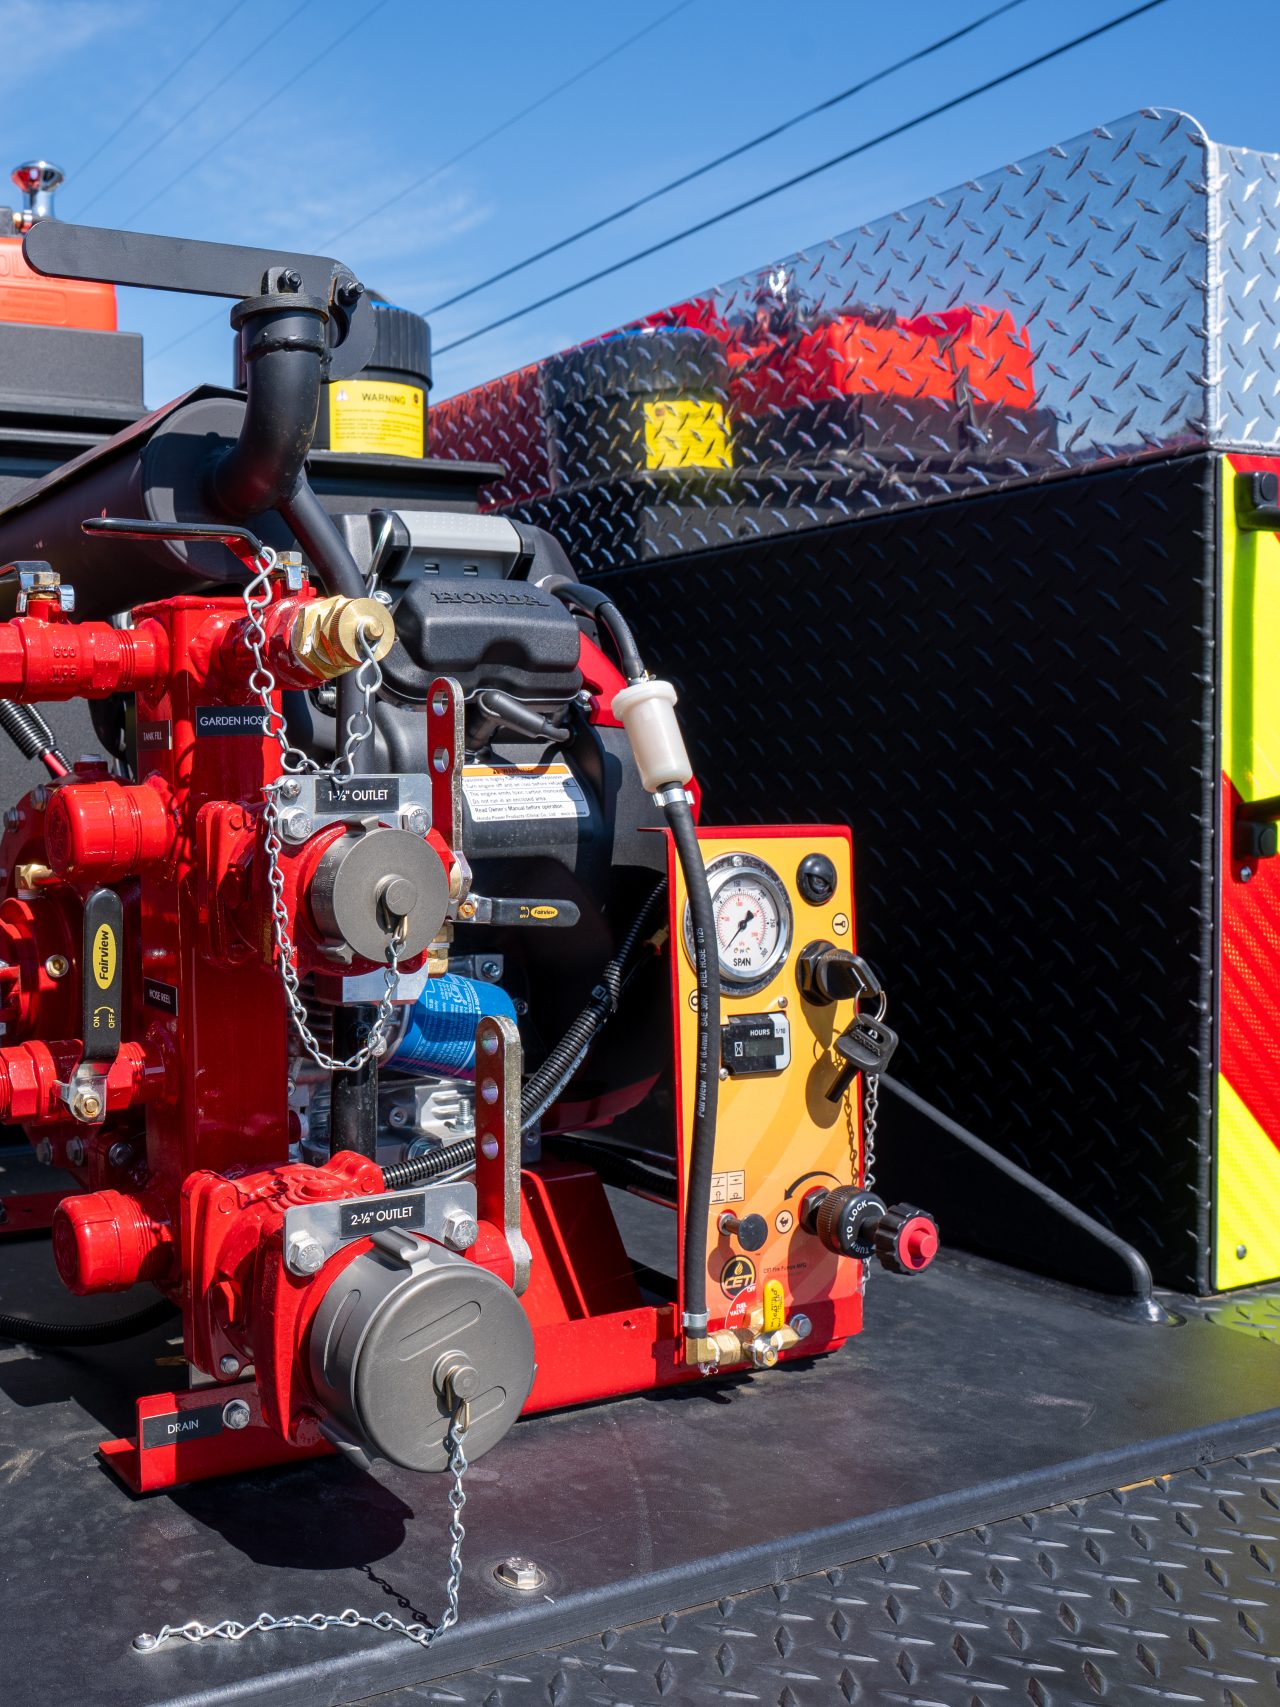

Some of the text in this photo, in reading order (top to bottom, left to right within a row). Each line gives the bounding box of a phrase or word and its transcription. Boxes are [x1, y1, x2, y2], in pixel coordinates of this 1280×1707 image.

[362, 392, 406, 406] WARNING
[430, 591, 550, 607] HONDA
[199, 715, 241, 726] GARDEN
[143, 731, 163, 742] TANK FILL
[351, 789, 389, 801] OUTLET
[534, 908, 556, 916] Fairview
[696, 927, 706, 943] 0125
[99, 930, 109, 981] Fairview
[698, 948, 707, 969] HOSE
[733, 957, 752, 967] SPAN
[699, 969, 709, 988] FUEL
[149, 988, 171, 1005] HOSE REEL
[93, 1016, 100, 1028] ON
[108, 1013, 116, 1029] OFF
[700, 1012, 709, 1027] SAE
[750, 1028, 771, 1037] HOURS
[696, 1080, 707, 1118] Fairview
[376, 1205, 414, 1222] OUTLET
[848, 1199, 868, 1222] LOCK
[846, 1225, 854, 1240] TO
[723, 1273, 753, 1290] CET
[729, 1308, 746, 1317] VALVE
[736, 1302, 748, 1310] FUEL
[167, 1419, 199, 1435] DRAIN
